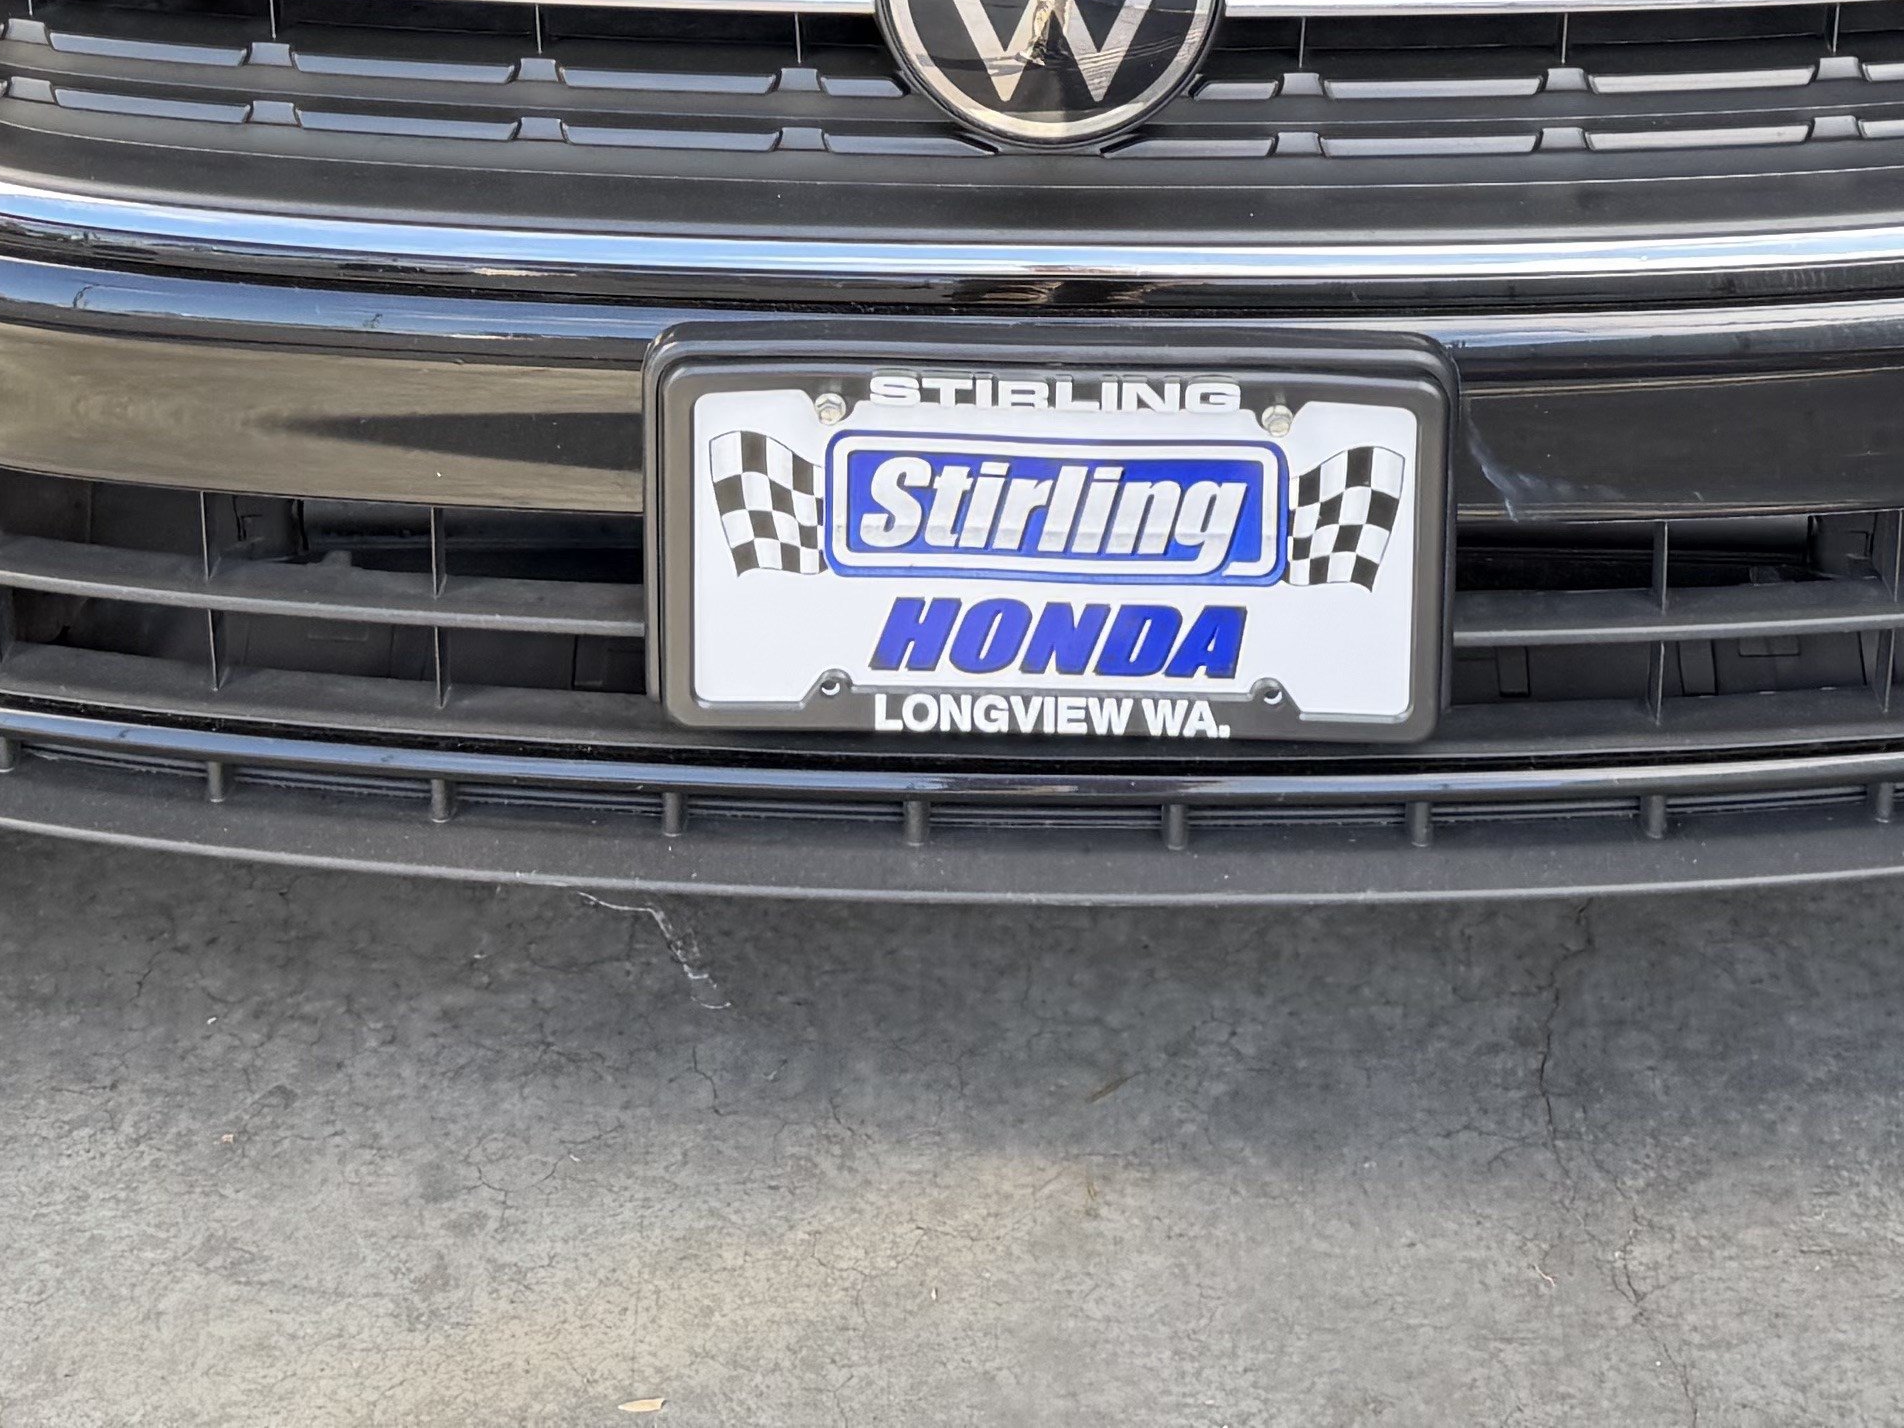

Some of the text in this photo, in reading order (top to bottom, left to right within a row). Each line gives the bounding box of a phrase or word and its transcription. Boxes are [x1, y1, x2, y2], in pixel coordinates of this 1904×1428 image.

[869, 372, 1242, 415] STIRLING
[859, 456, 1249, 574] Stirling
[867, 595, 1248, 680] HONDA
[873, 692, 1232, 740] LONGVIEW WA.
